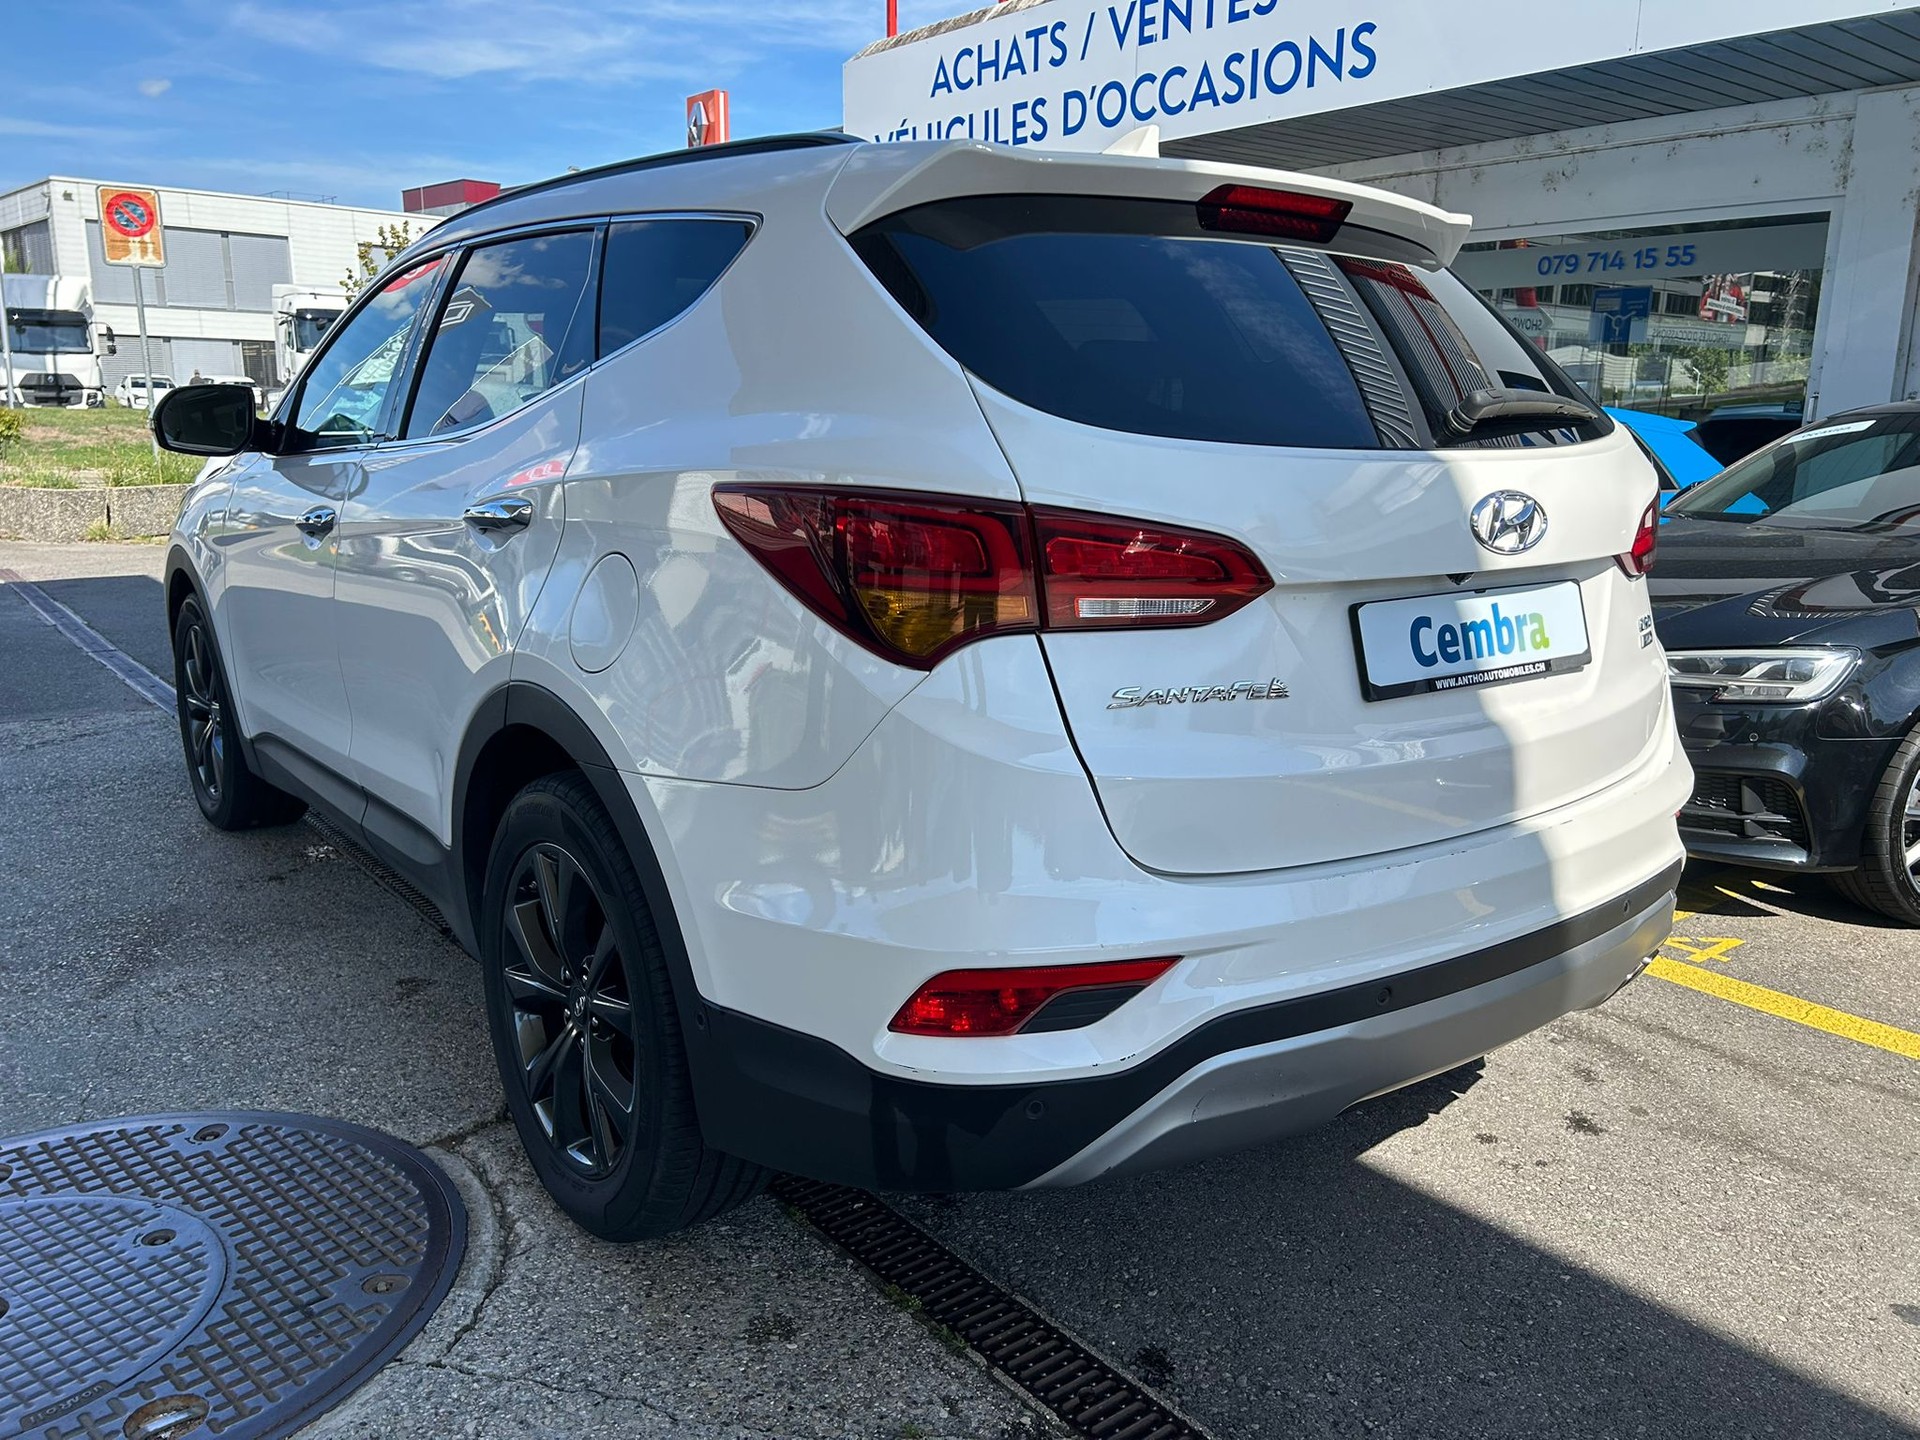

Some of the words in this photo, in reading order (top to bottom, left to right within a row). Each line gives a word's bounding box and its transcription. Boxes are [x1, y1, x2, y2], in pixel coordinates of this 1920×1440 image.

[930, 20, 1067, 98] ACHATS
[1062, 21, 1378, 137] D'OCCASIONS
[1537, 253, 1579, 276] 079
[1586, 250, 1625, 272] 714
[1633, 247, 1657, 269] 15
[1664, 244, 1697, 267] 55
[1410, 602, 1551, 668] Cembra
[1435, 662, 1546, 689] WWW.ANTHOAUTOMOBILES.CH
